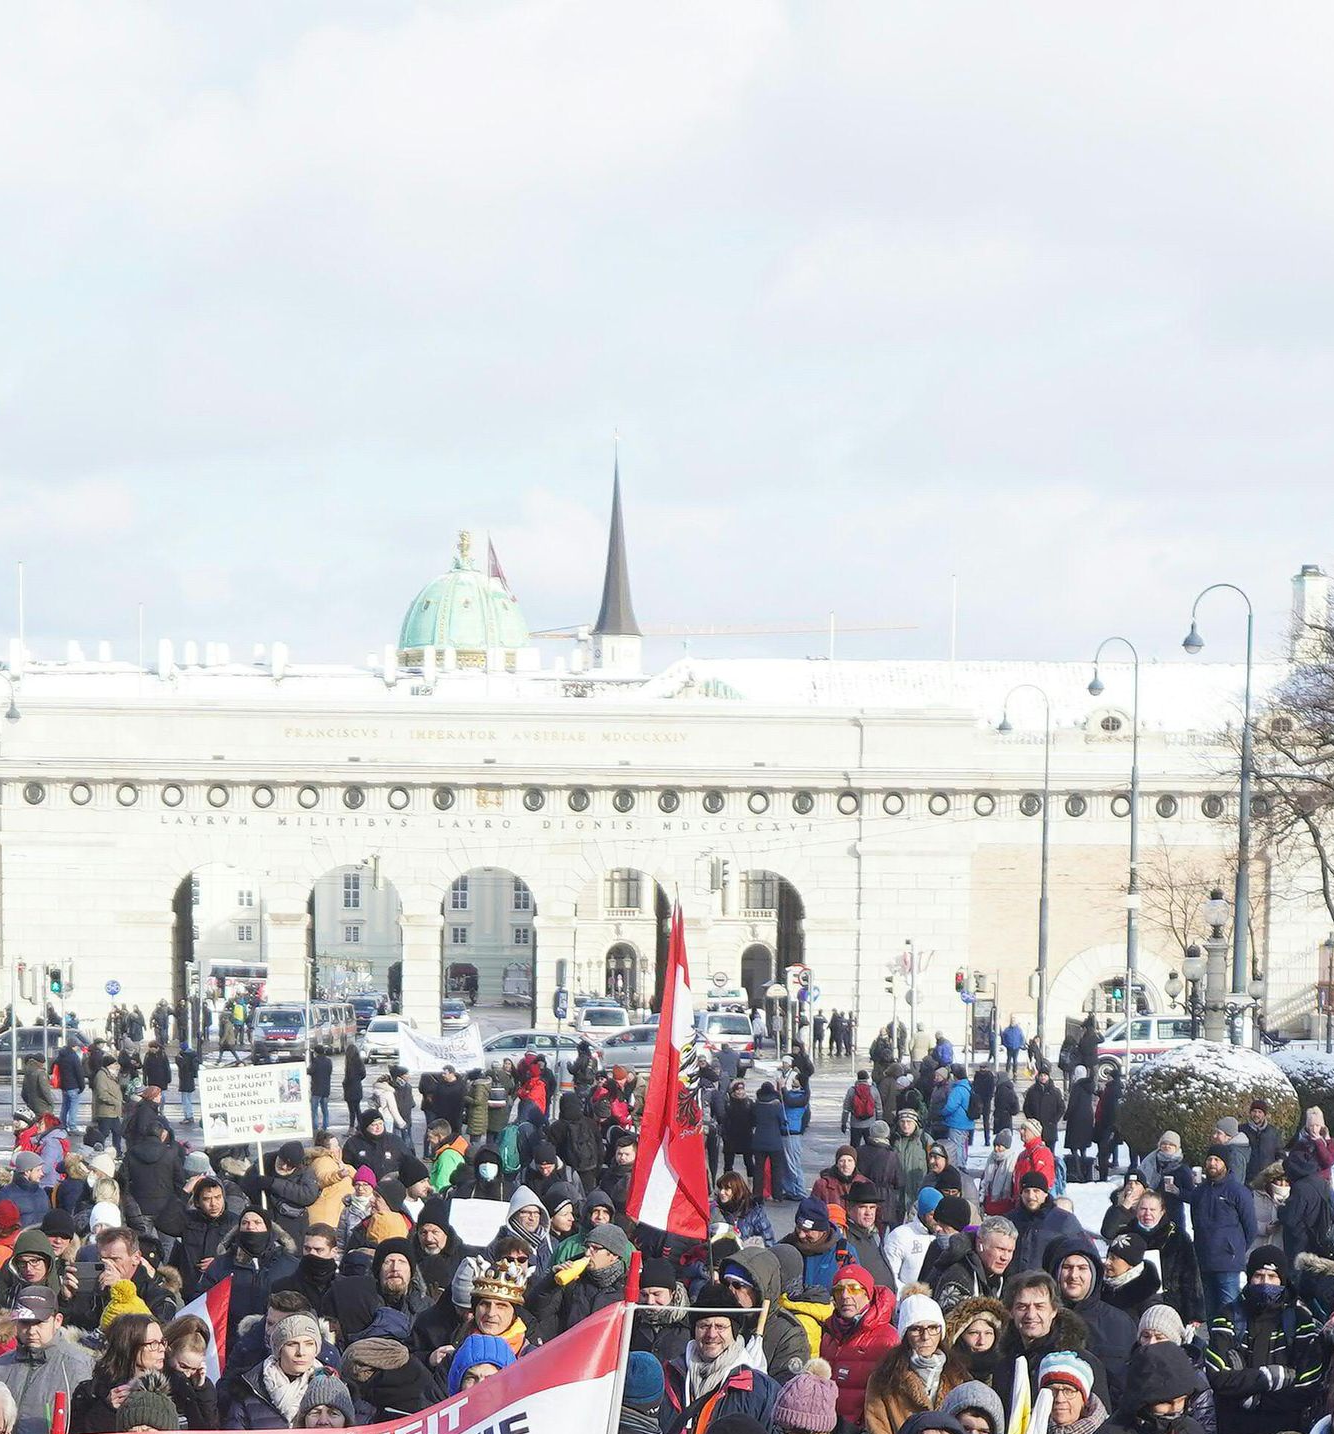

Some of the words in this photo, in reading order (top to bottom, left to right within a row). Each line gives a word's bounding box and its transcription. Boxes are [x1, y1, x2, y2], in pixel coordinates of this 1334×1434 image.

[244, 1071, 273, 1080] NICHT
[228, 1080, 274, 1090] ZUKUNFT
[223, 1090, 259, 1099] MEINER
[208, 1098, 276, 1109] ENKELKINDER
